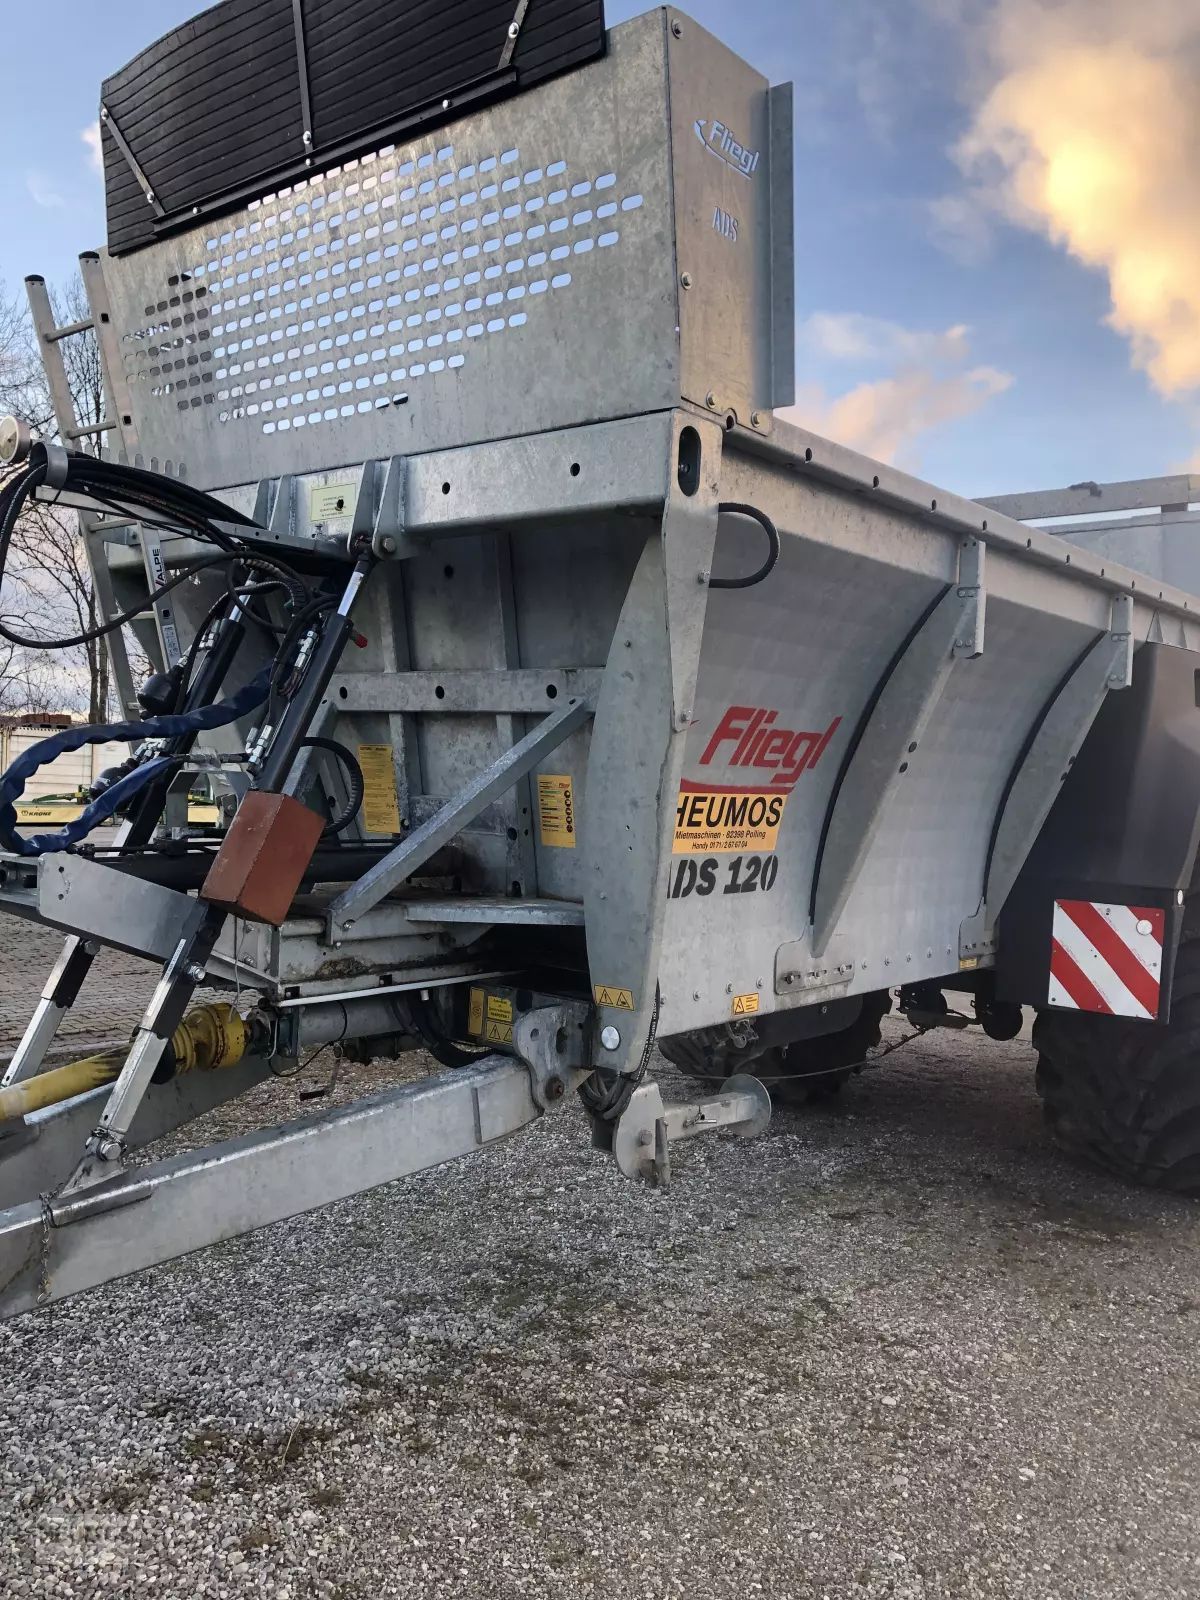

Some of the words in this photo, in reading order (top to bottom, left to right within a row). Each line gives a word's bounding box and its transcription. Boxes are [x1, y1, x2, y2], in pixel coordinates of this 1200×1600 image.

[709, 119, 760, 173] Fliegl
[712, 206, 738, 242] ADS
[152, 548, 165, 581] ALPE
[699, 706, 843, 784] Fliegl
[675, 831, 721, 840] Mietmaschinen
[745, 830, 766, 839] Polling
[691, 841, 708, 850] Handy
[667, 858, 719, 898] DS
[723, 855, 779, 894] 120
